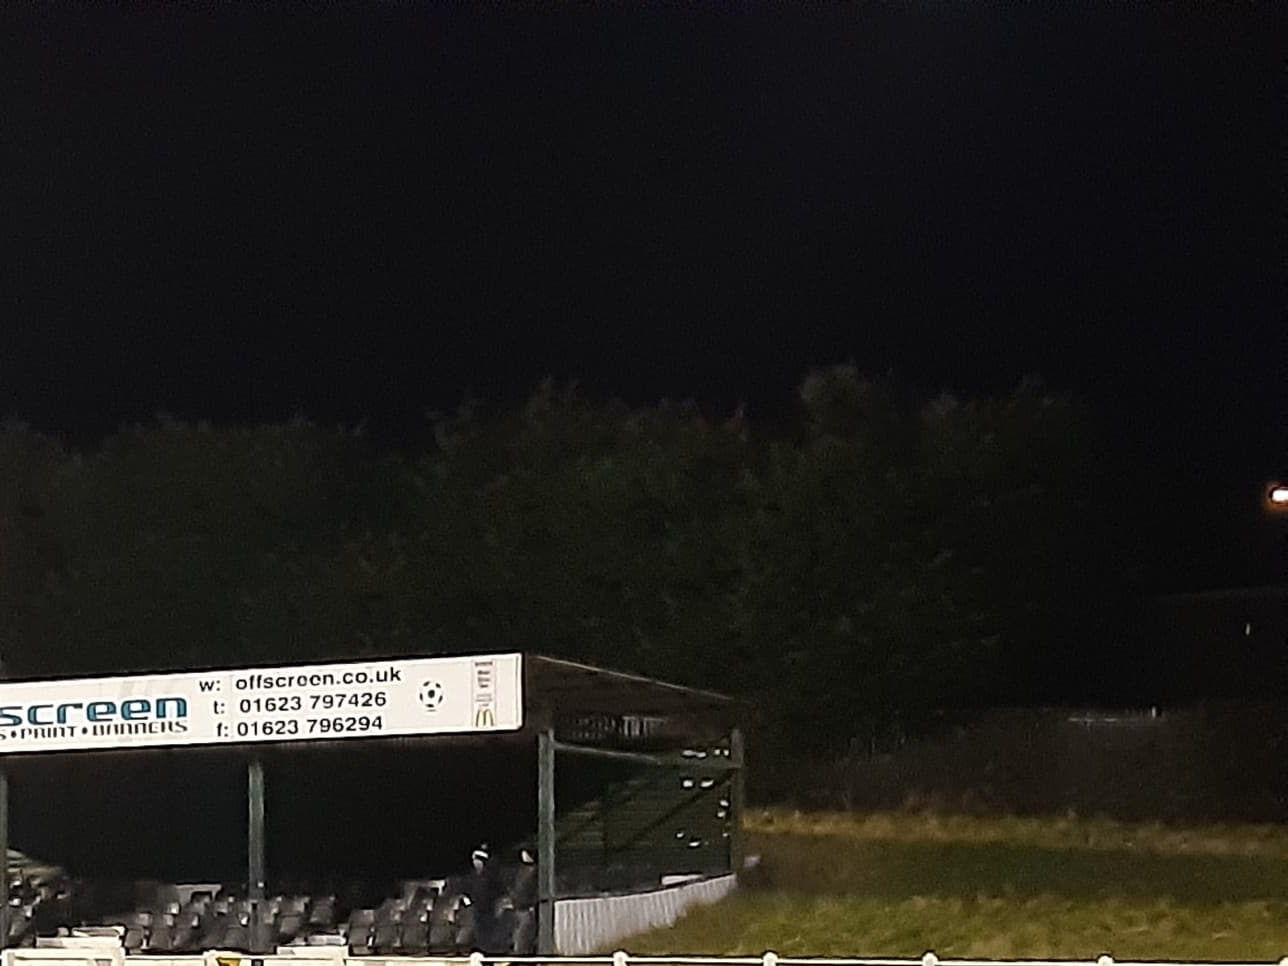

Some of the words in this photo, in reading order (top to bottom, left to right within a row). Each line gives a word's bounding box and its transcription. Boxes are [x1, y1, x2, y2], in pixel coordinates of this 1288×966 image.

[198, 680, 221, 693] w:
[234, 667, 402, 691] offscreen.co.uk
[213, 700, 225, 715] t:
[239, 696, 303, 714] 01623
[310, 691, 387, 709] 797426
[216, 722, 229, 738] f:
[237, 719, 300, 737] 01623
[306, 715, 384, 734] 796294
